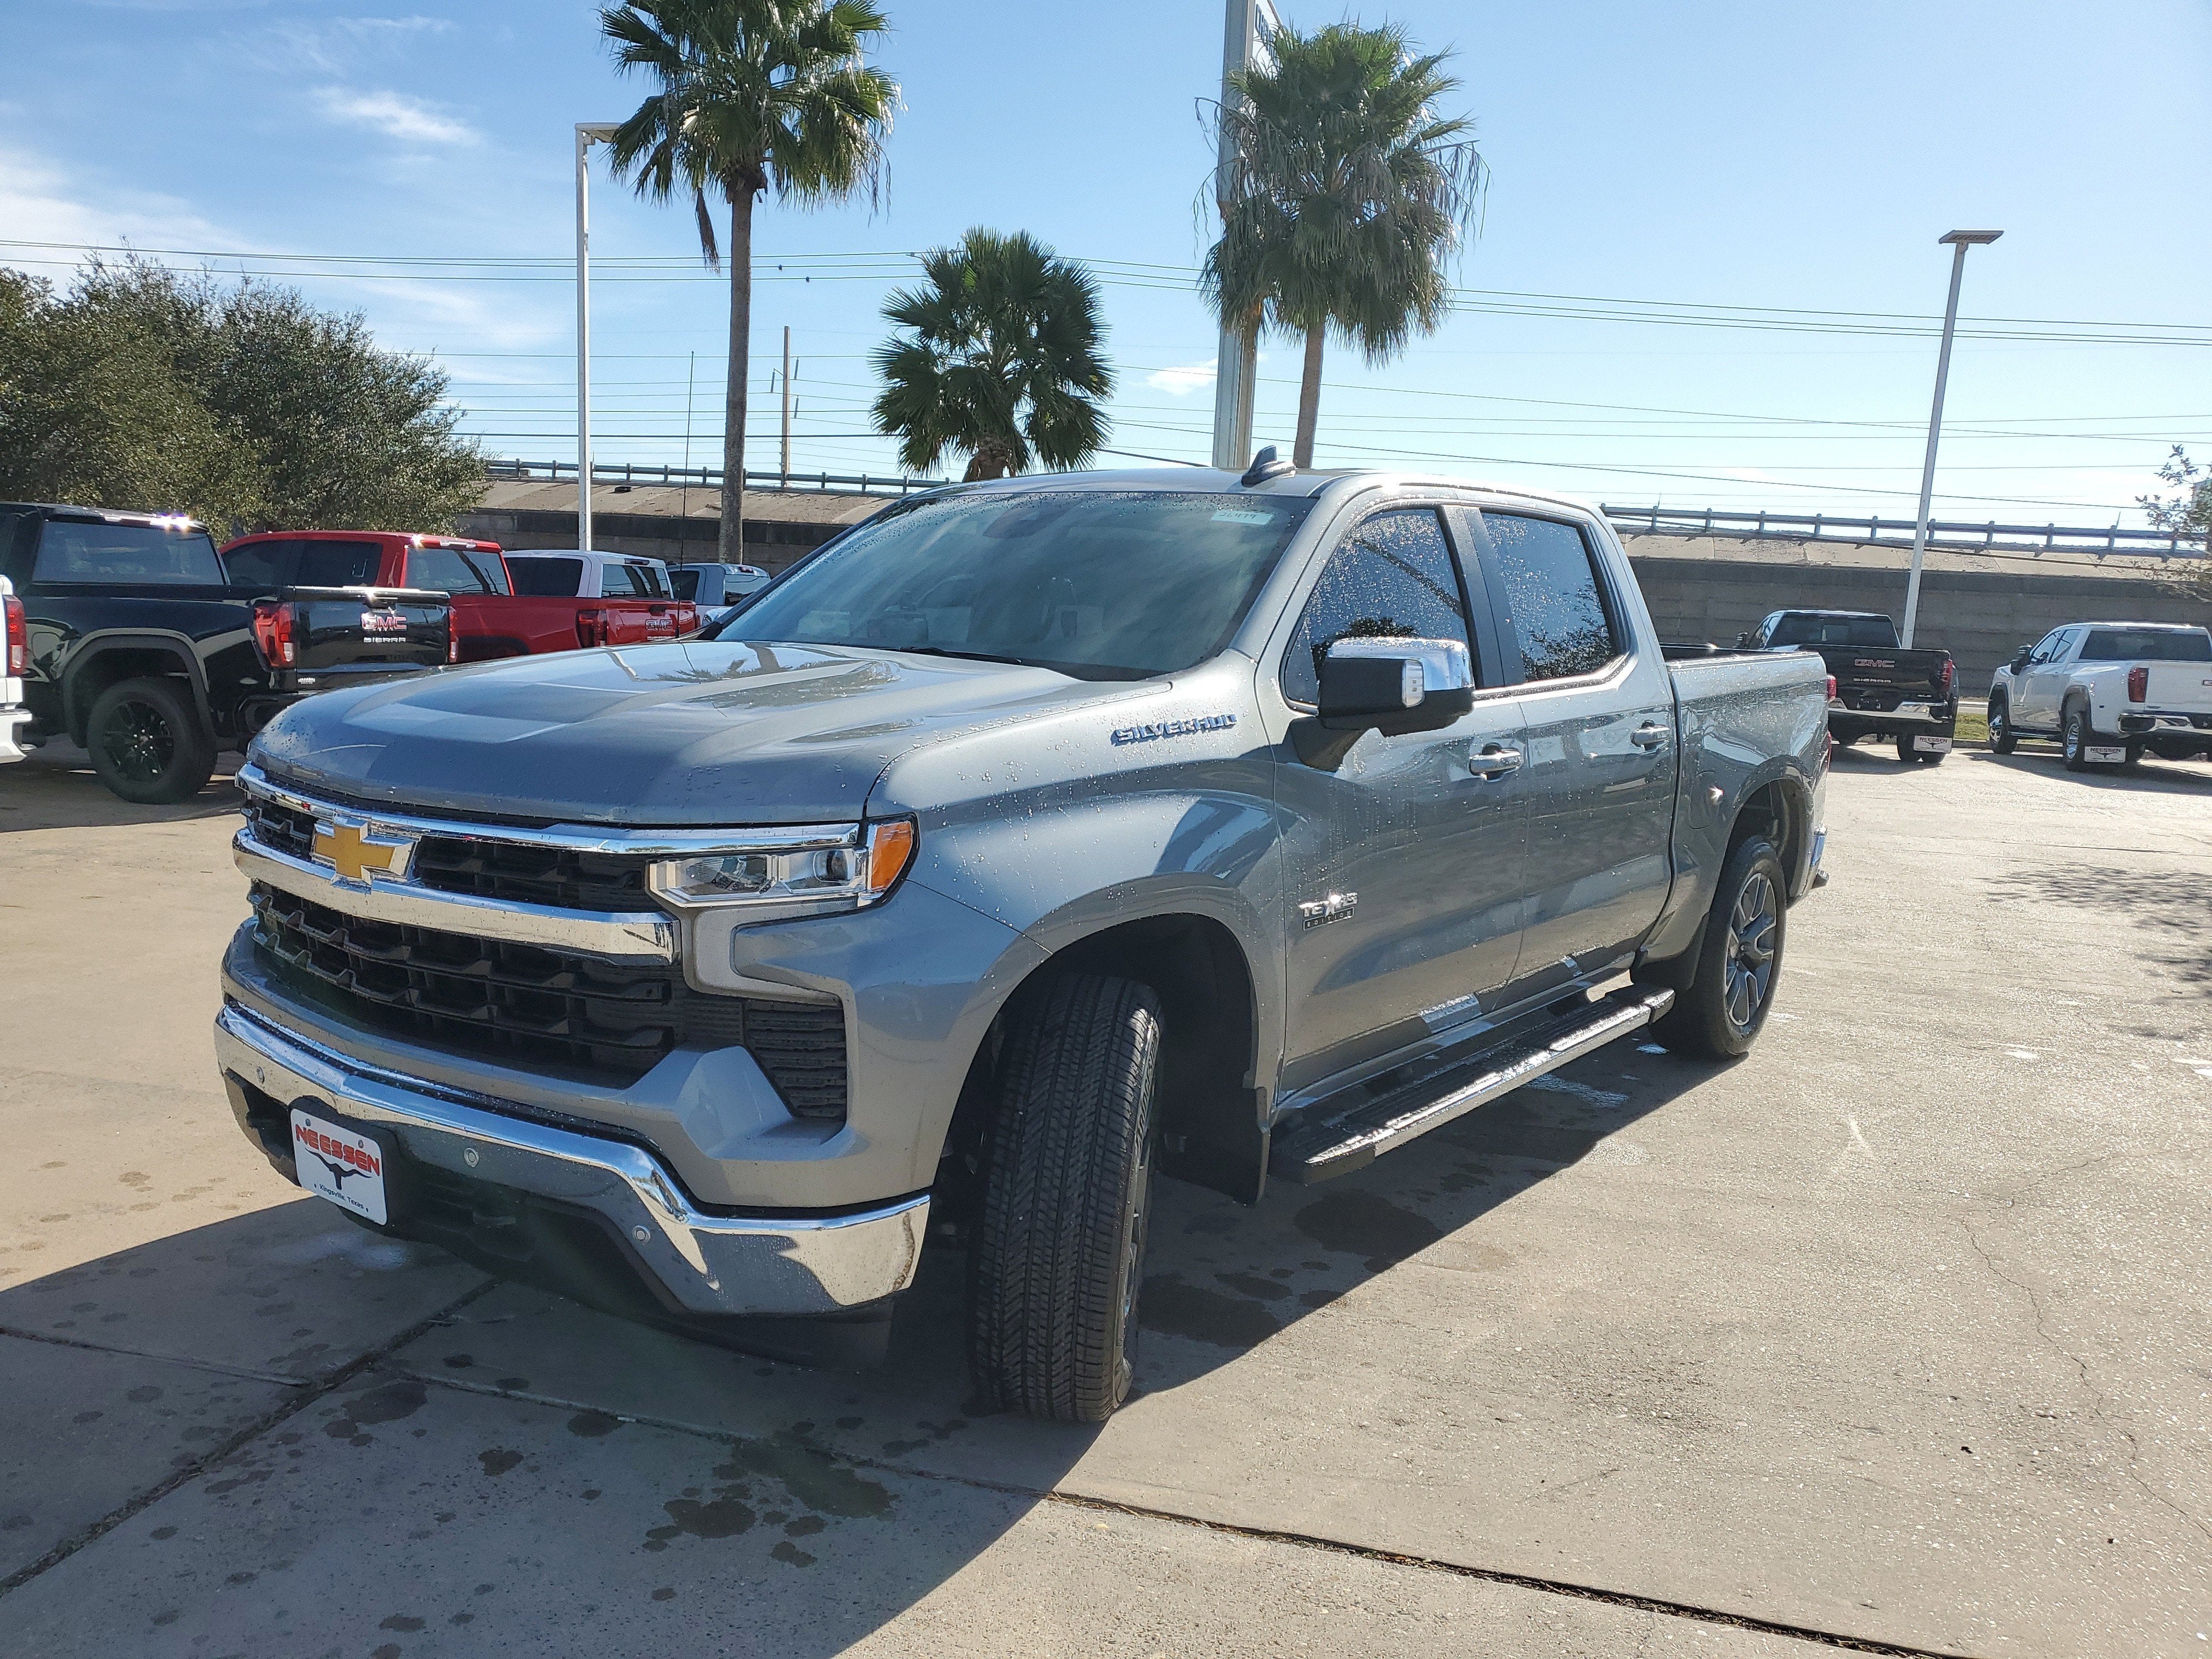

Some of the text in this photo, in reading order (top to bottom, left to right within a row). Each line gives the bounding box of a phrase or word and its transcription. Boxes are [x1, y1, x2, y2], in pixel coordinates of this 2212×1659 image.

[362, 613, 407, 630] GMC
[1855, 659, 1895, 668] GMC
[1111, 714, 1237, 744] SILVERADO
[1307, 910, 1351, 927] EDITION
[295, 1124, 380, 1176] NEESSEN
[347, 1197, 364, 1209] Texas
